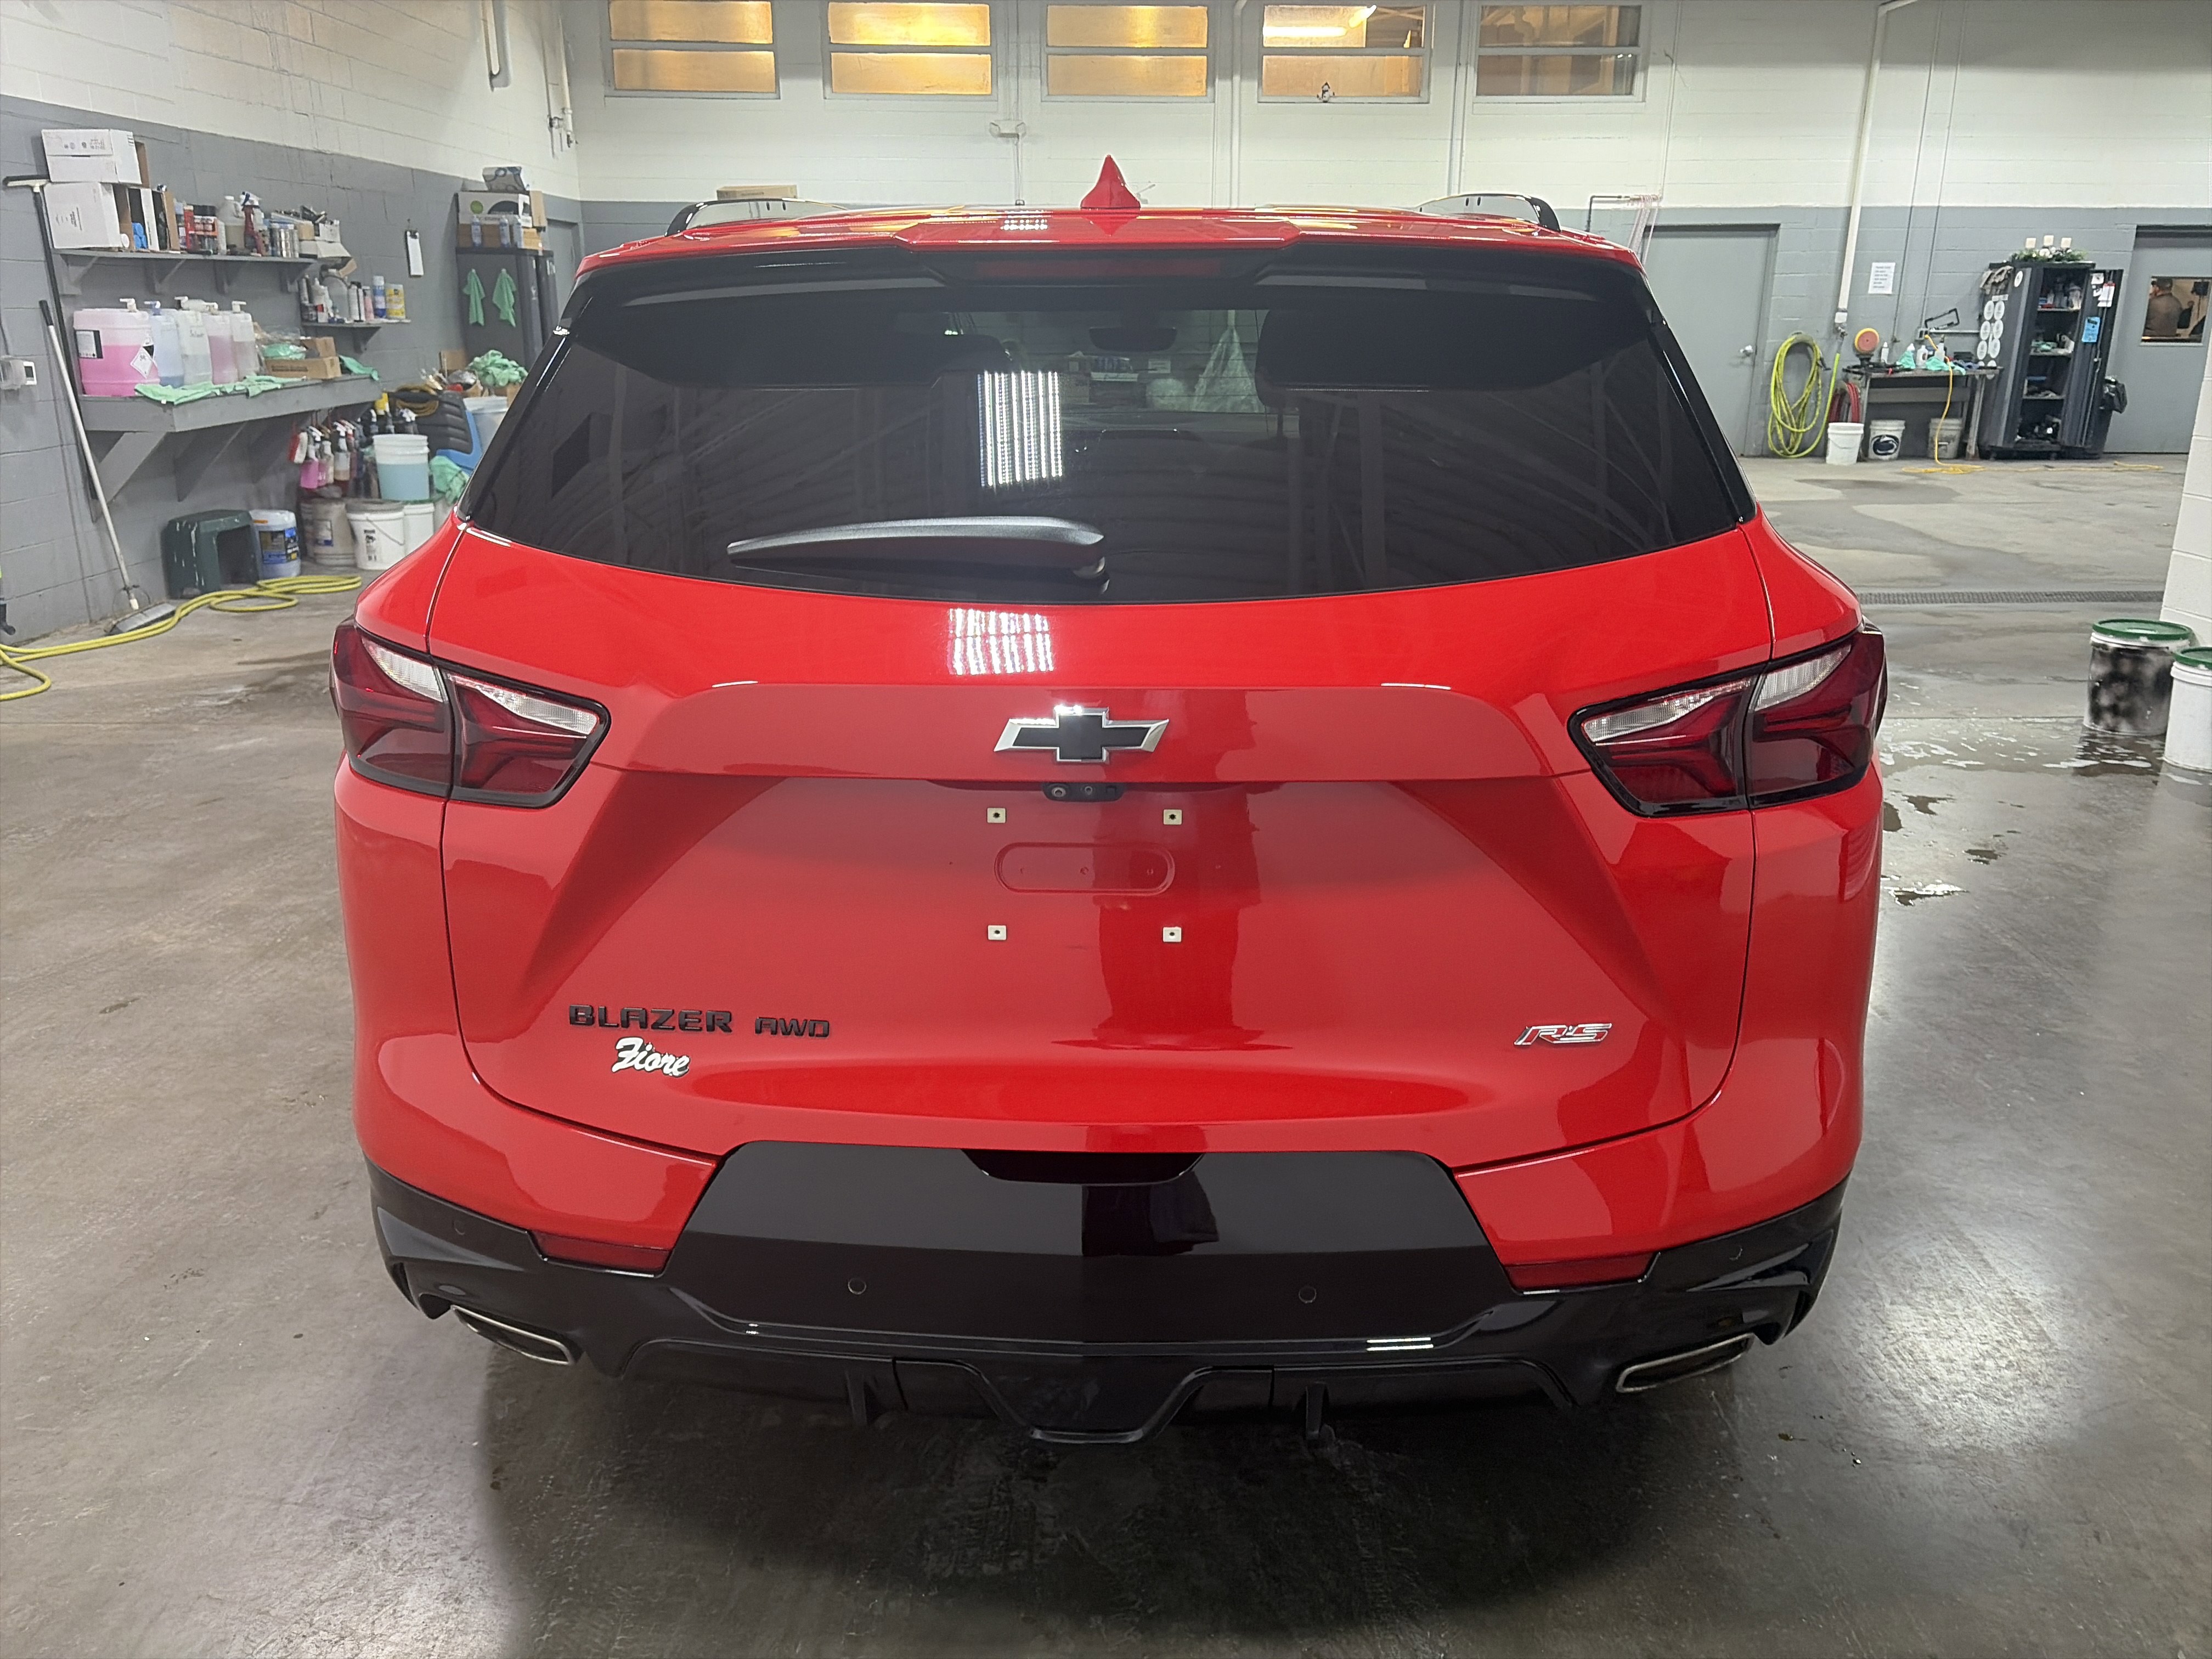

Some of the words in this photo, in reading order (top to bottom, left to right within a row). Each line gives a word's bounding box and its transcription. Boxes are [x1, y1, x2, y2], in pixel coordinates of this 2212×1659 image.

[568, 1005, 732, 1034] BLAZER
[754, 1017, 830, 1039] AWD
[1514, 1023, 1612, 1045] RS
[611, 1036, 690, 1077] Fiore
